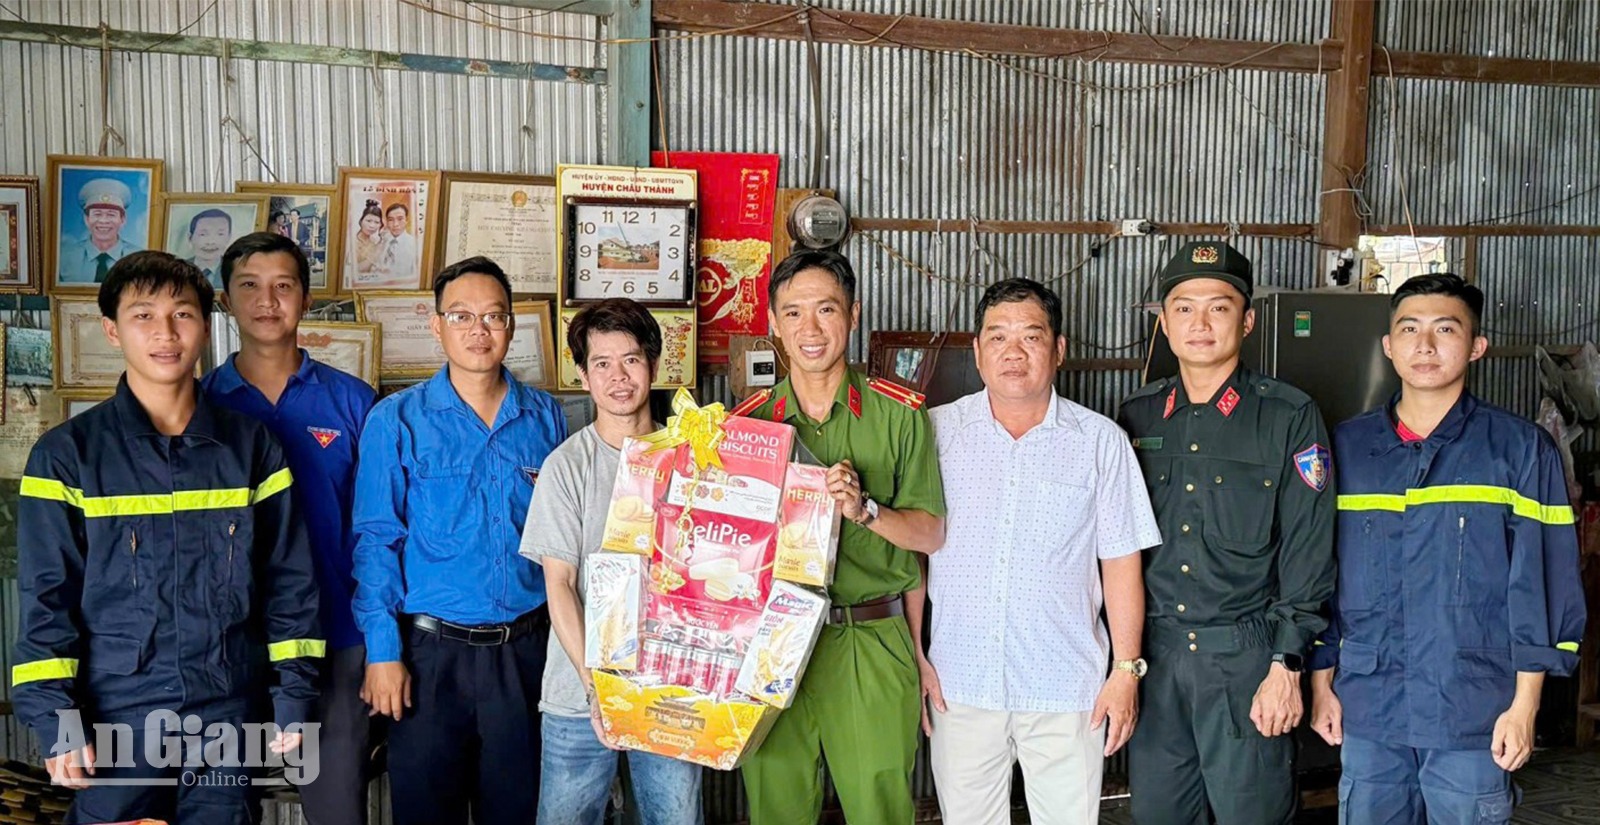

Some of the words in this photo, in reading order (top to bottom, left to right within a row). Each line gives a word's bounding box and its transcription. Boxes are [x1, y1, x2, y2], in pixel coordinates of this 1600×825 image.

[582, 183, 614, 193] HUYỆN
[616, 183, 641, 193] CHÂU
[643, 184, 675, 194] THÀNH
[602, 210, 613, 223] 11
[622, 211, 640, 224] 12
[650, 211, 657, 224] 1
[578, 222, 596, 234] 10
[669, 224, 681, 237] 2
[579, 245, 592, 258] 9
[667, 247, 680, 259] 3
[579, 269, 591, 281] 8
[668, 269, 680, 282] 4
[601, 281, 613, 293] 7
[623, 281, 635, 294] 6
[647, 281, 659, 295] 5
[718, 441, 777, 459] BISCUITS
[627, 463, 665, 484] ERRY
[693, 520, 752, 548] eliPie
